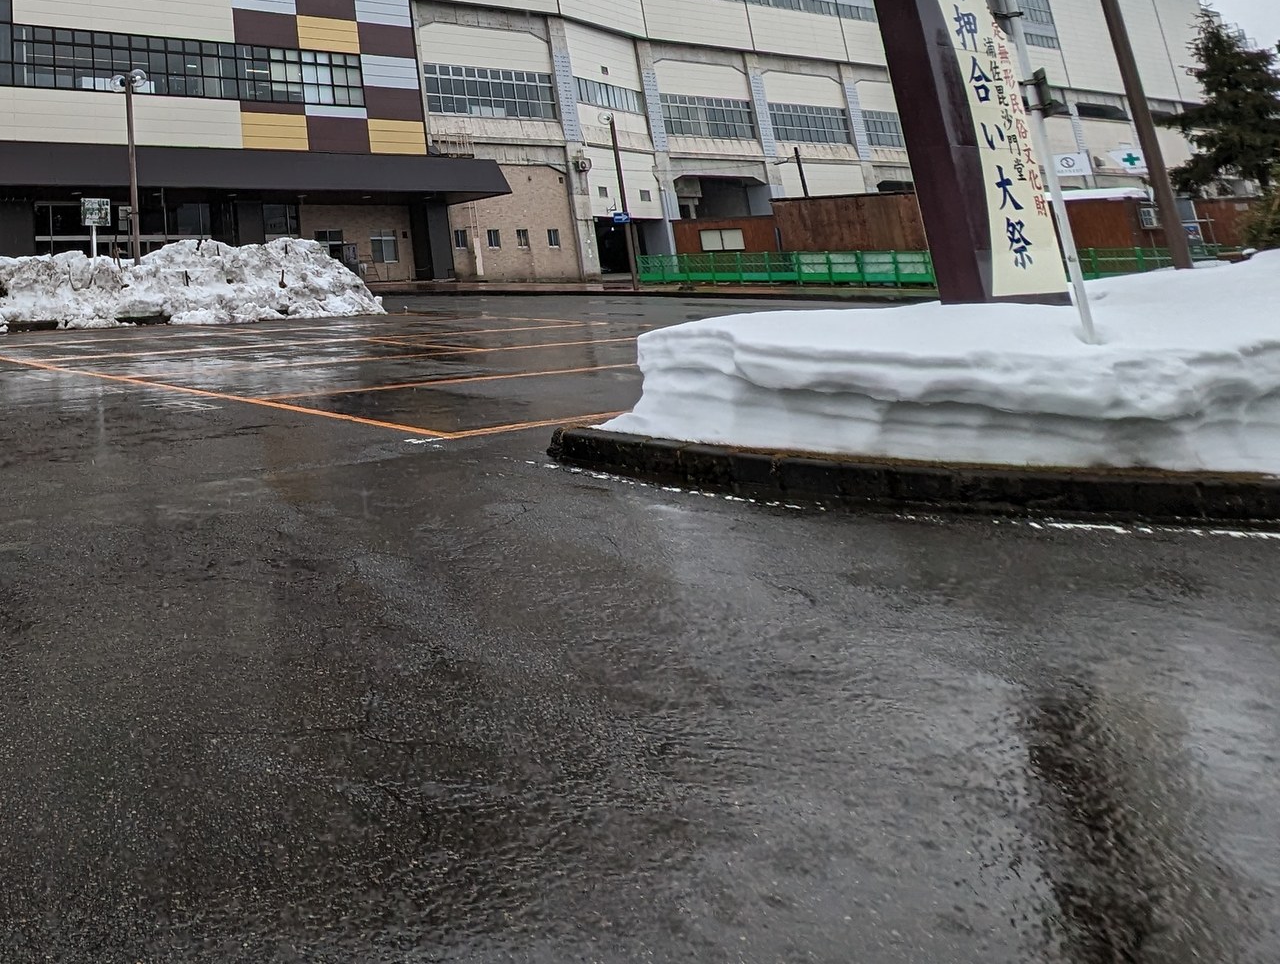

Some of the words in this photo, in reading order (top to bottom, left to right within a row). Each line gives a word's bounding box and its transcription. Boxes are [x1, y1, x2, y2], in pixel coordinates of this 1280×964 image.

[983, 37, 1027, 182] 浦佐毘沙門堂
